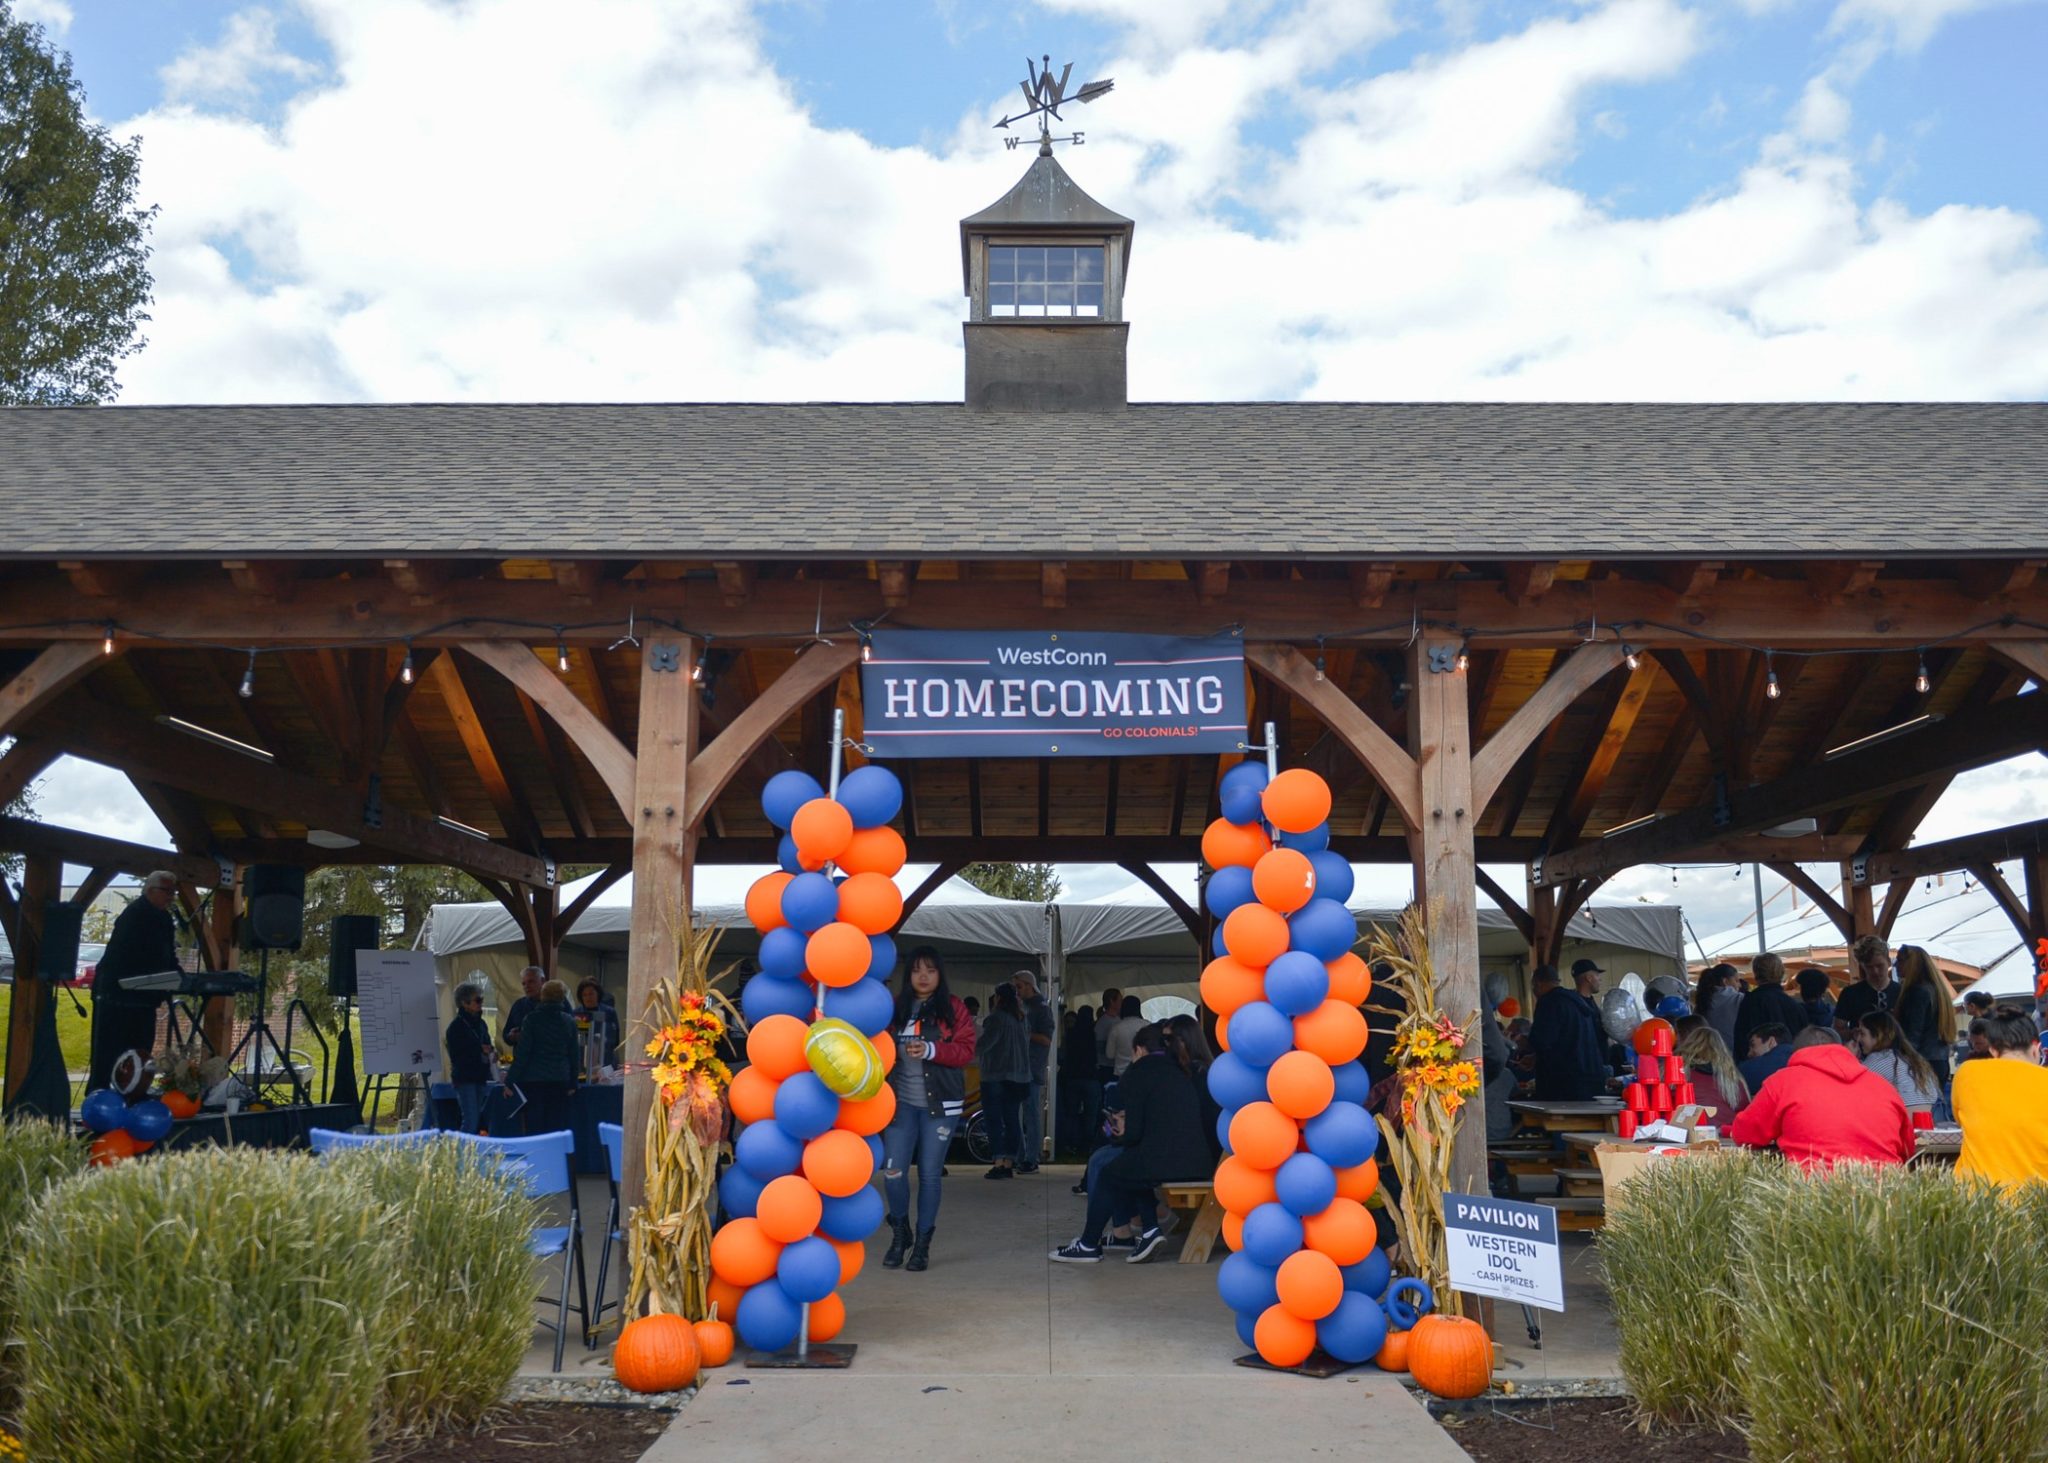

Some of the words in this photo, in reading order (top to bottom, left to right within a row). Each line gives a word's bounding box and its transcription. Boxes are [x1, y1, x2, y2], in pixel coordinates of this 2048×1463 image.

[1003, 136, 1020, 150] W
[1072, 132, 1085, 145] E
[997, 647, 1107, 665] WestConn
[884, 675, 1224, 718] HOMECOMING
[1103, 727, 1123, 738] GO
[1125, 726, 1198, 738] COLONIALS!
[1457, 1203, 1540, 1231] PAVILION
[1466, 1233, 1537, 1258] WESTERN
[1487, 1253, 1522, 1272] IDOL
